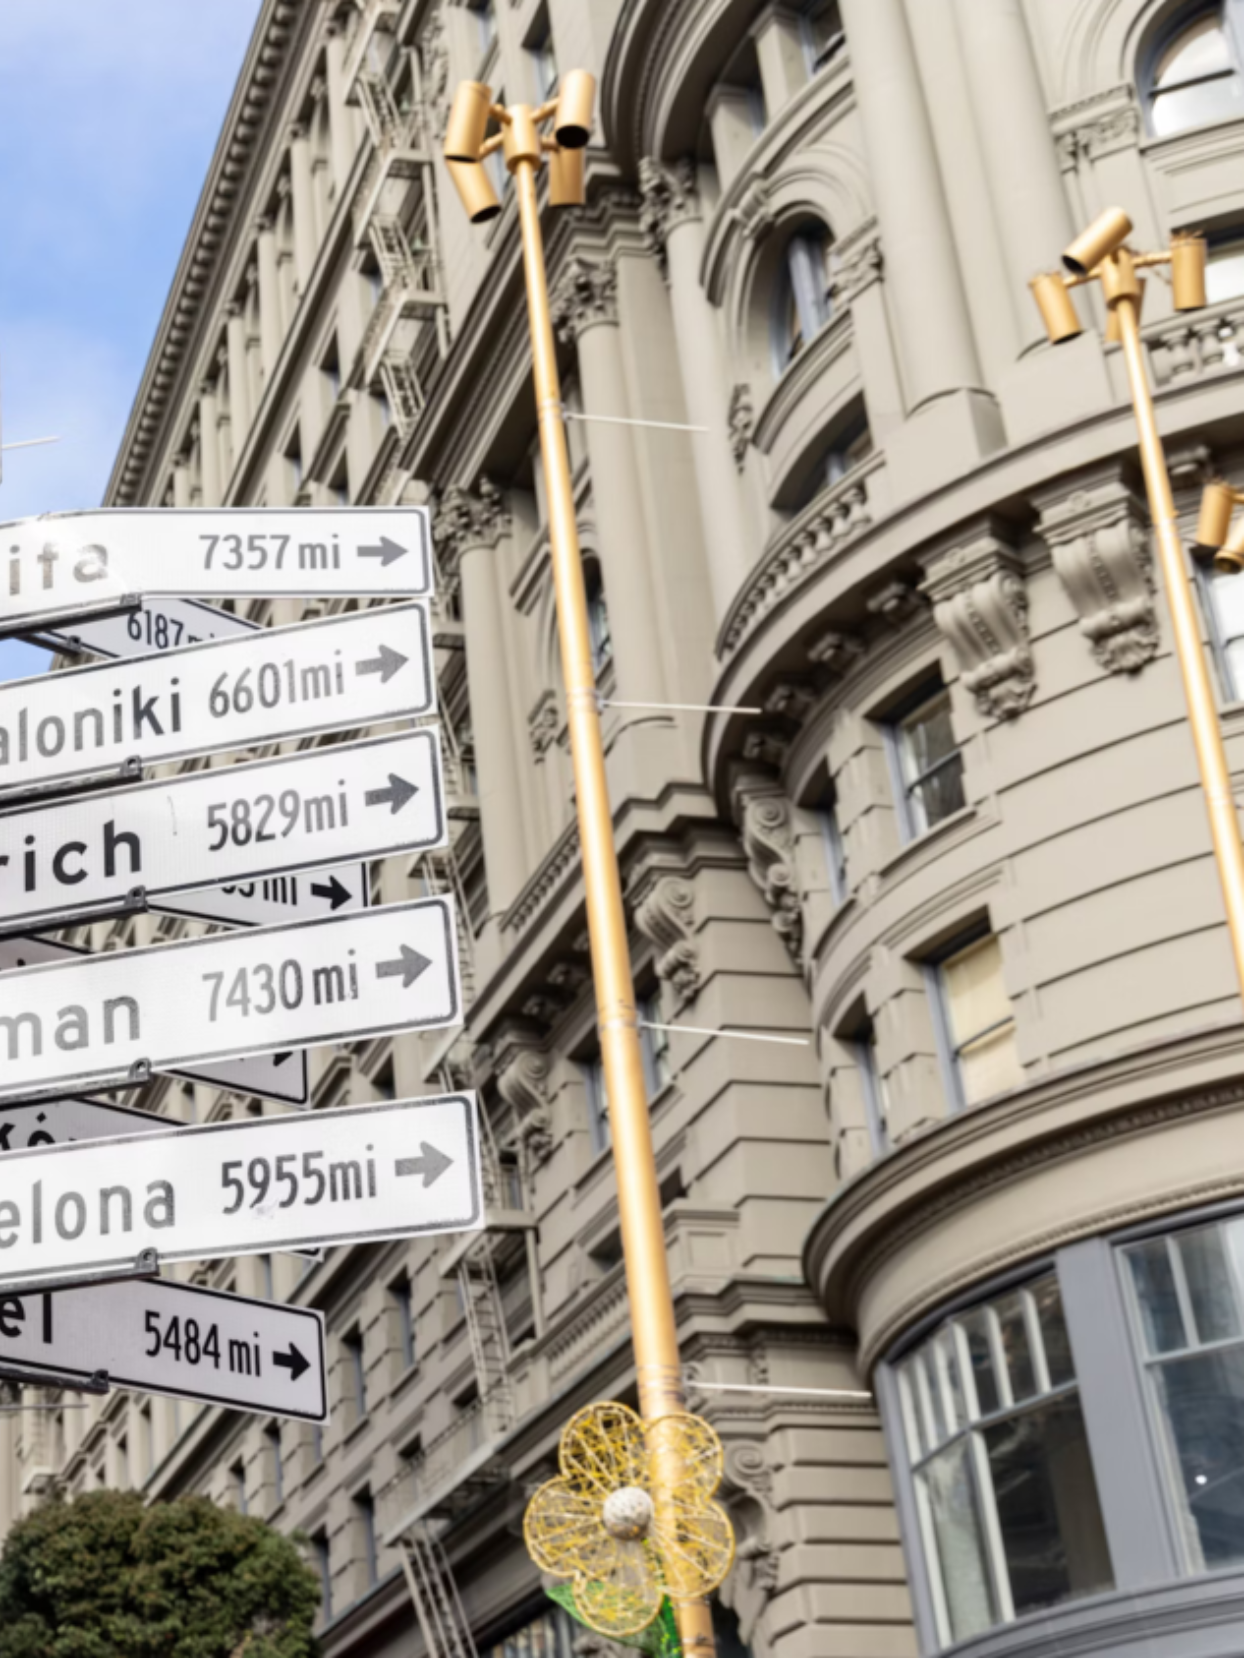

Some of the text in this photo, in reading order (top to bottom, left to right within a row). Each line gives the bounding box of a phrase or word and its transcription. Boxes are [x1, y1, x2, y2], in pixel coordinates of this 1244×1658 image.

[207, 650, 345, 718] 6601mi
[207, 779, 349, 851] 5829mi
[220, 1143, 378, 1215] 5955mi
